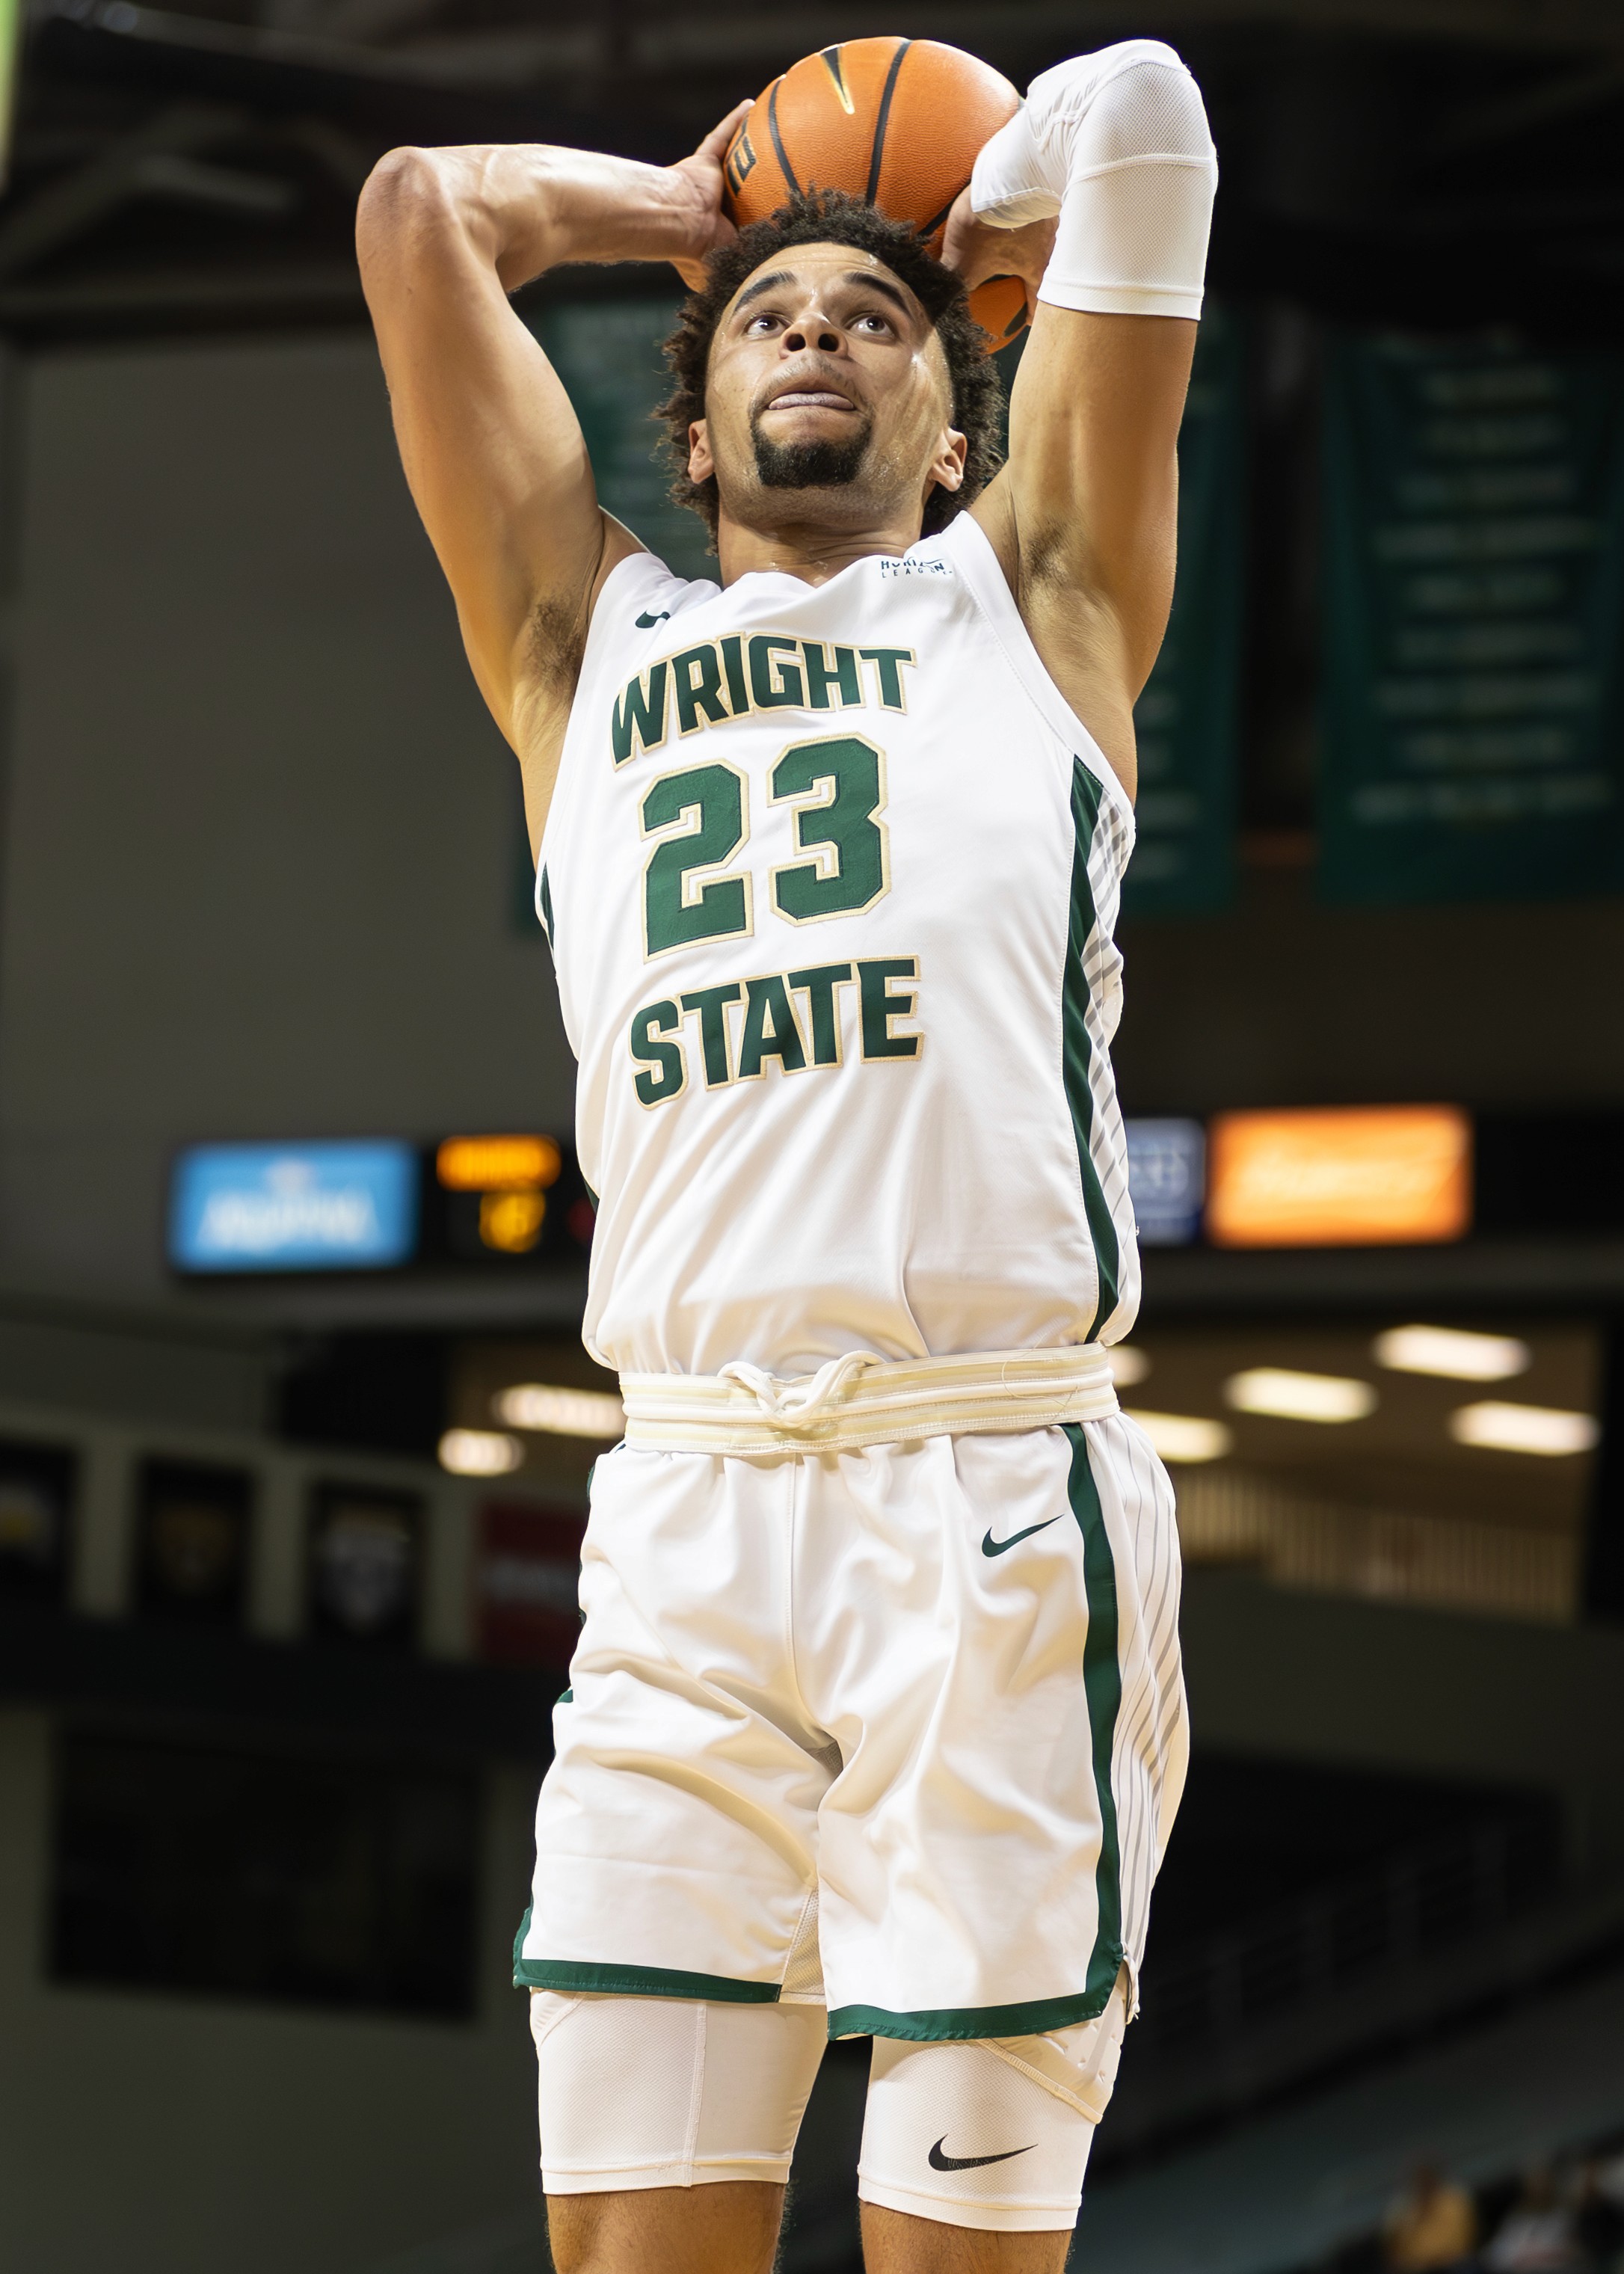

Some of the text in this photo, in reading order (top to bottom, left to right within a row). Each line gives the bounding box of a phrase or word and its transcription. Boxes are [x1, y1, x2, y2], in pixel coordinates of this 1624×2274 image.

[611, 630, 917, 772] WRIGHT
[637, 731, 892, 964] 23
[628, 955, 924, 1110] STATE
